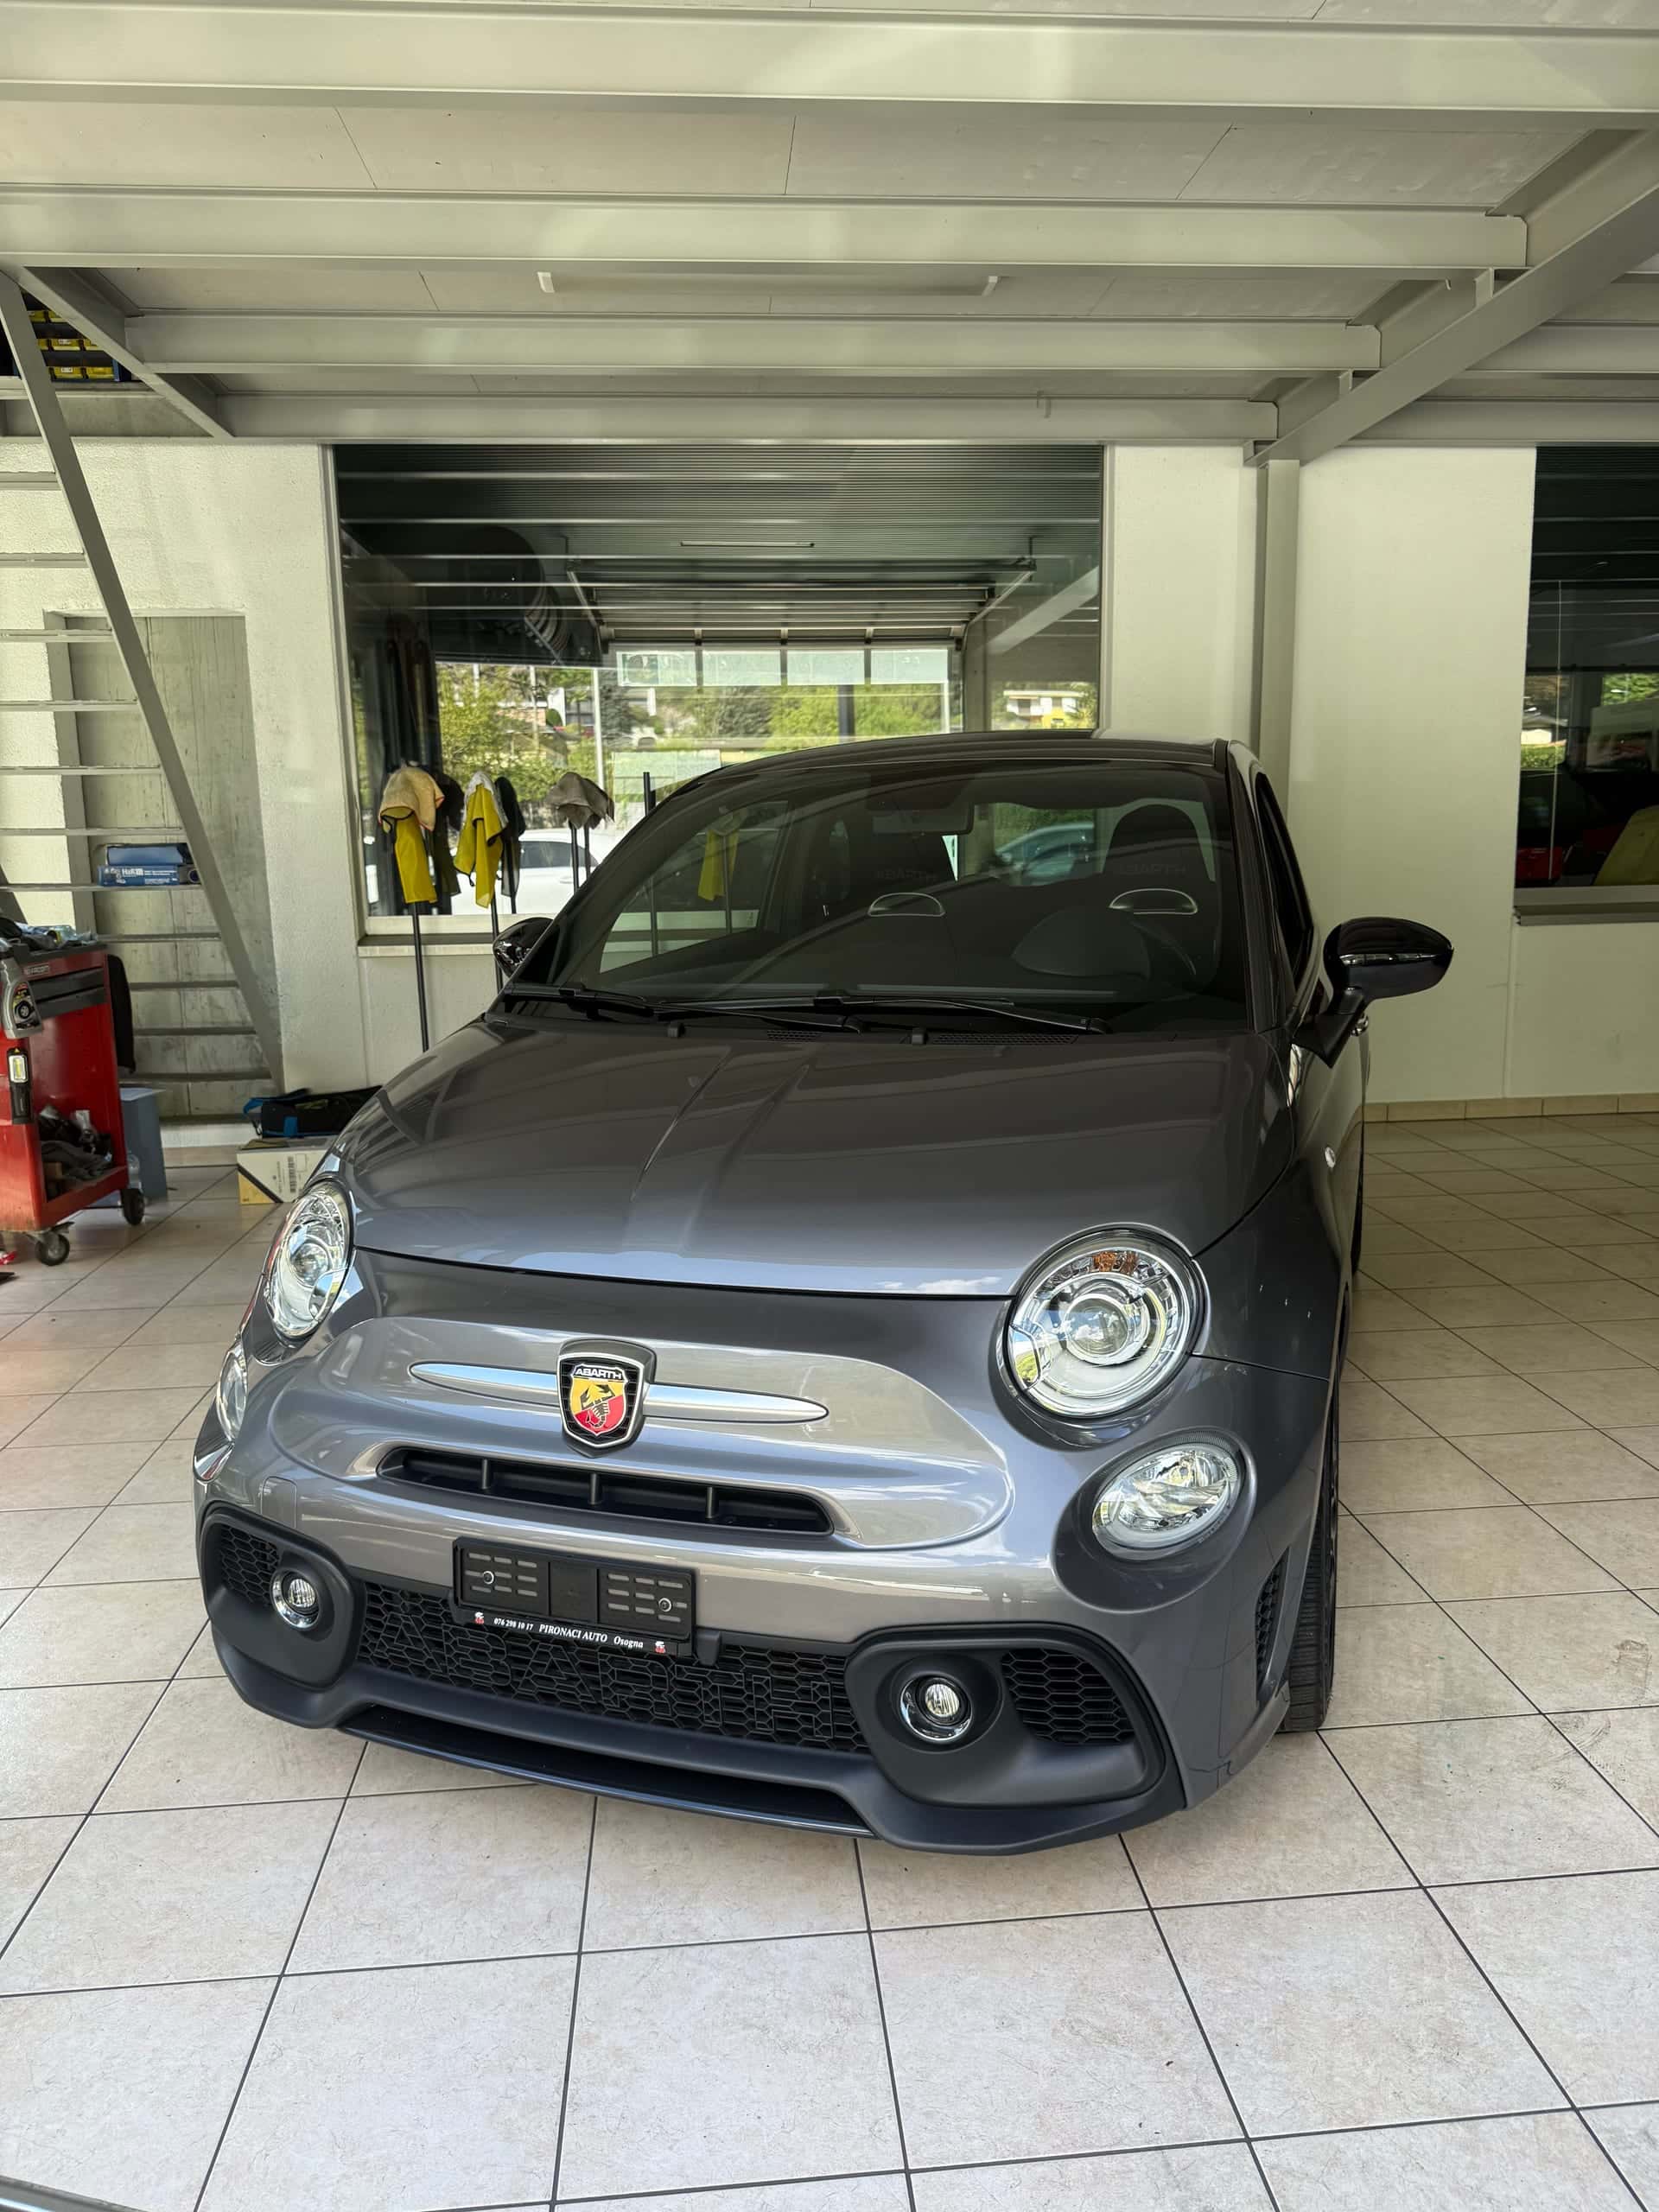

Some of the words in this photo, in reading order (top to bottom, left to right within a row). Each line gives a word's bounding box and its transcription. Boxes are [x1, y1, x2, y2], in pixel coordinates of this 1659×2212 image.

[575, 1368, 622, 1379] ABARTH
[518, 1621, 525, 1630] 10
[538, 1624, 582, 1639] PIRONACI
[582, 1630, 608, 1643] AUTO
[613, 1636, 644, 1649] Osogna
[374, 1612, 834, 1739] ABARTH
